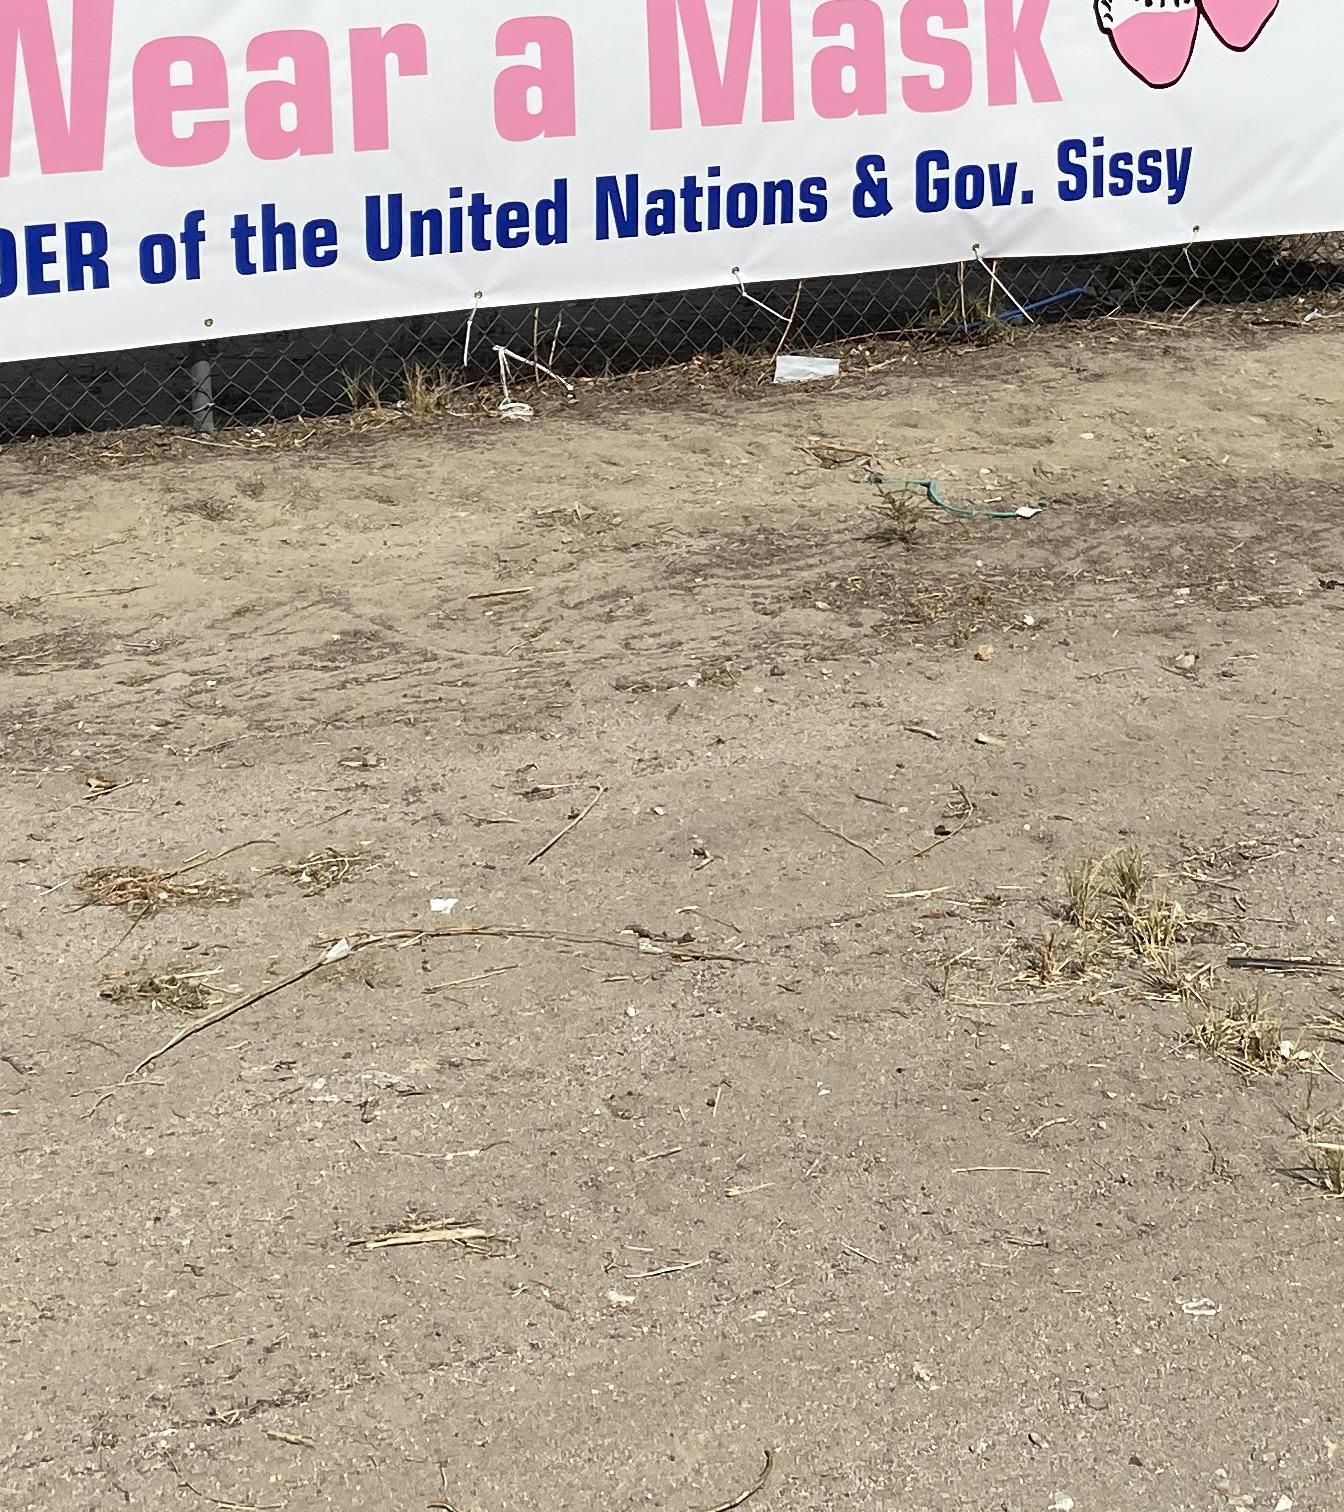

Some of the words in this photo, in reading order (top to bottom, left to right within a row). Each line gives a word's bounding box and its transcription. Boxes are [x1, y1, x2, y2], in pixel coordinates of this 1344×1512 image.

[494, 15, 577, 142] a
[139, 209, 206, 285] of
[230, 203, 338, 275] the
[365, 178, 569, 262] United
[595, 169, 829, 242] Nations
[852, 154, 895, 219] &
[915, 149, 1035, 214] Gov.
[1057, 134, 1193, 205] Sissy
